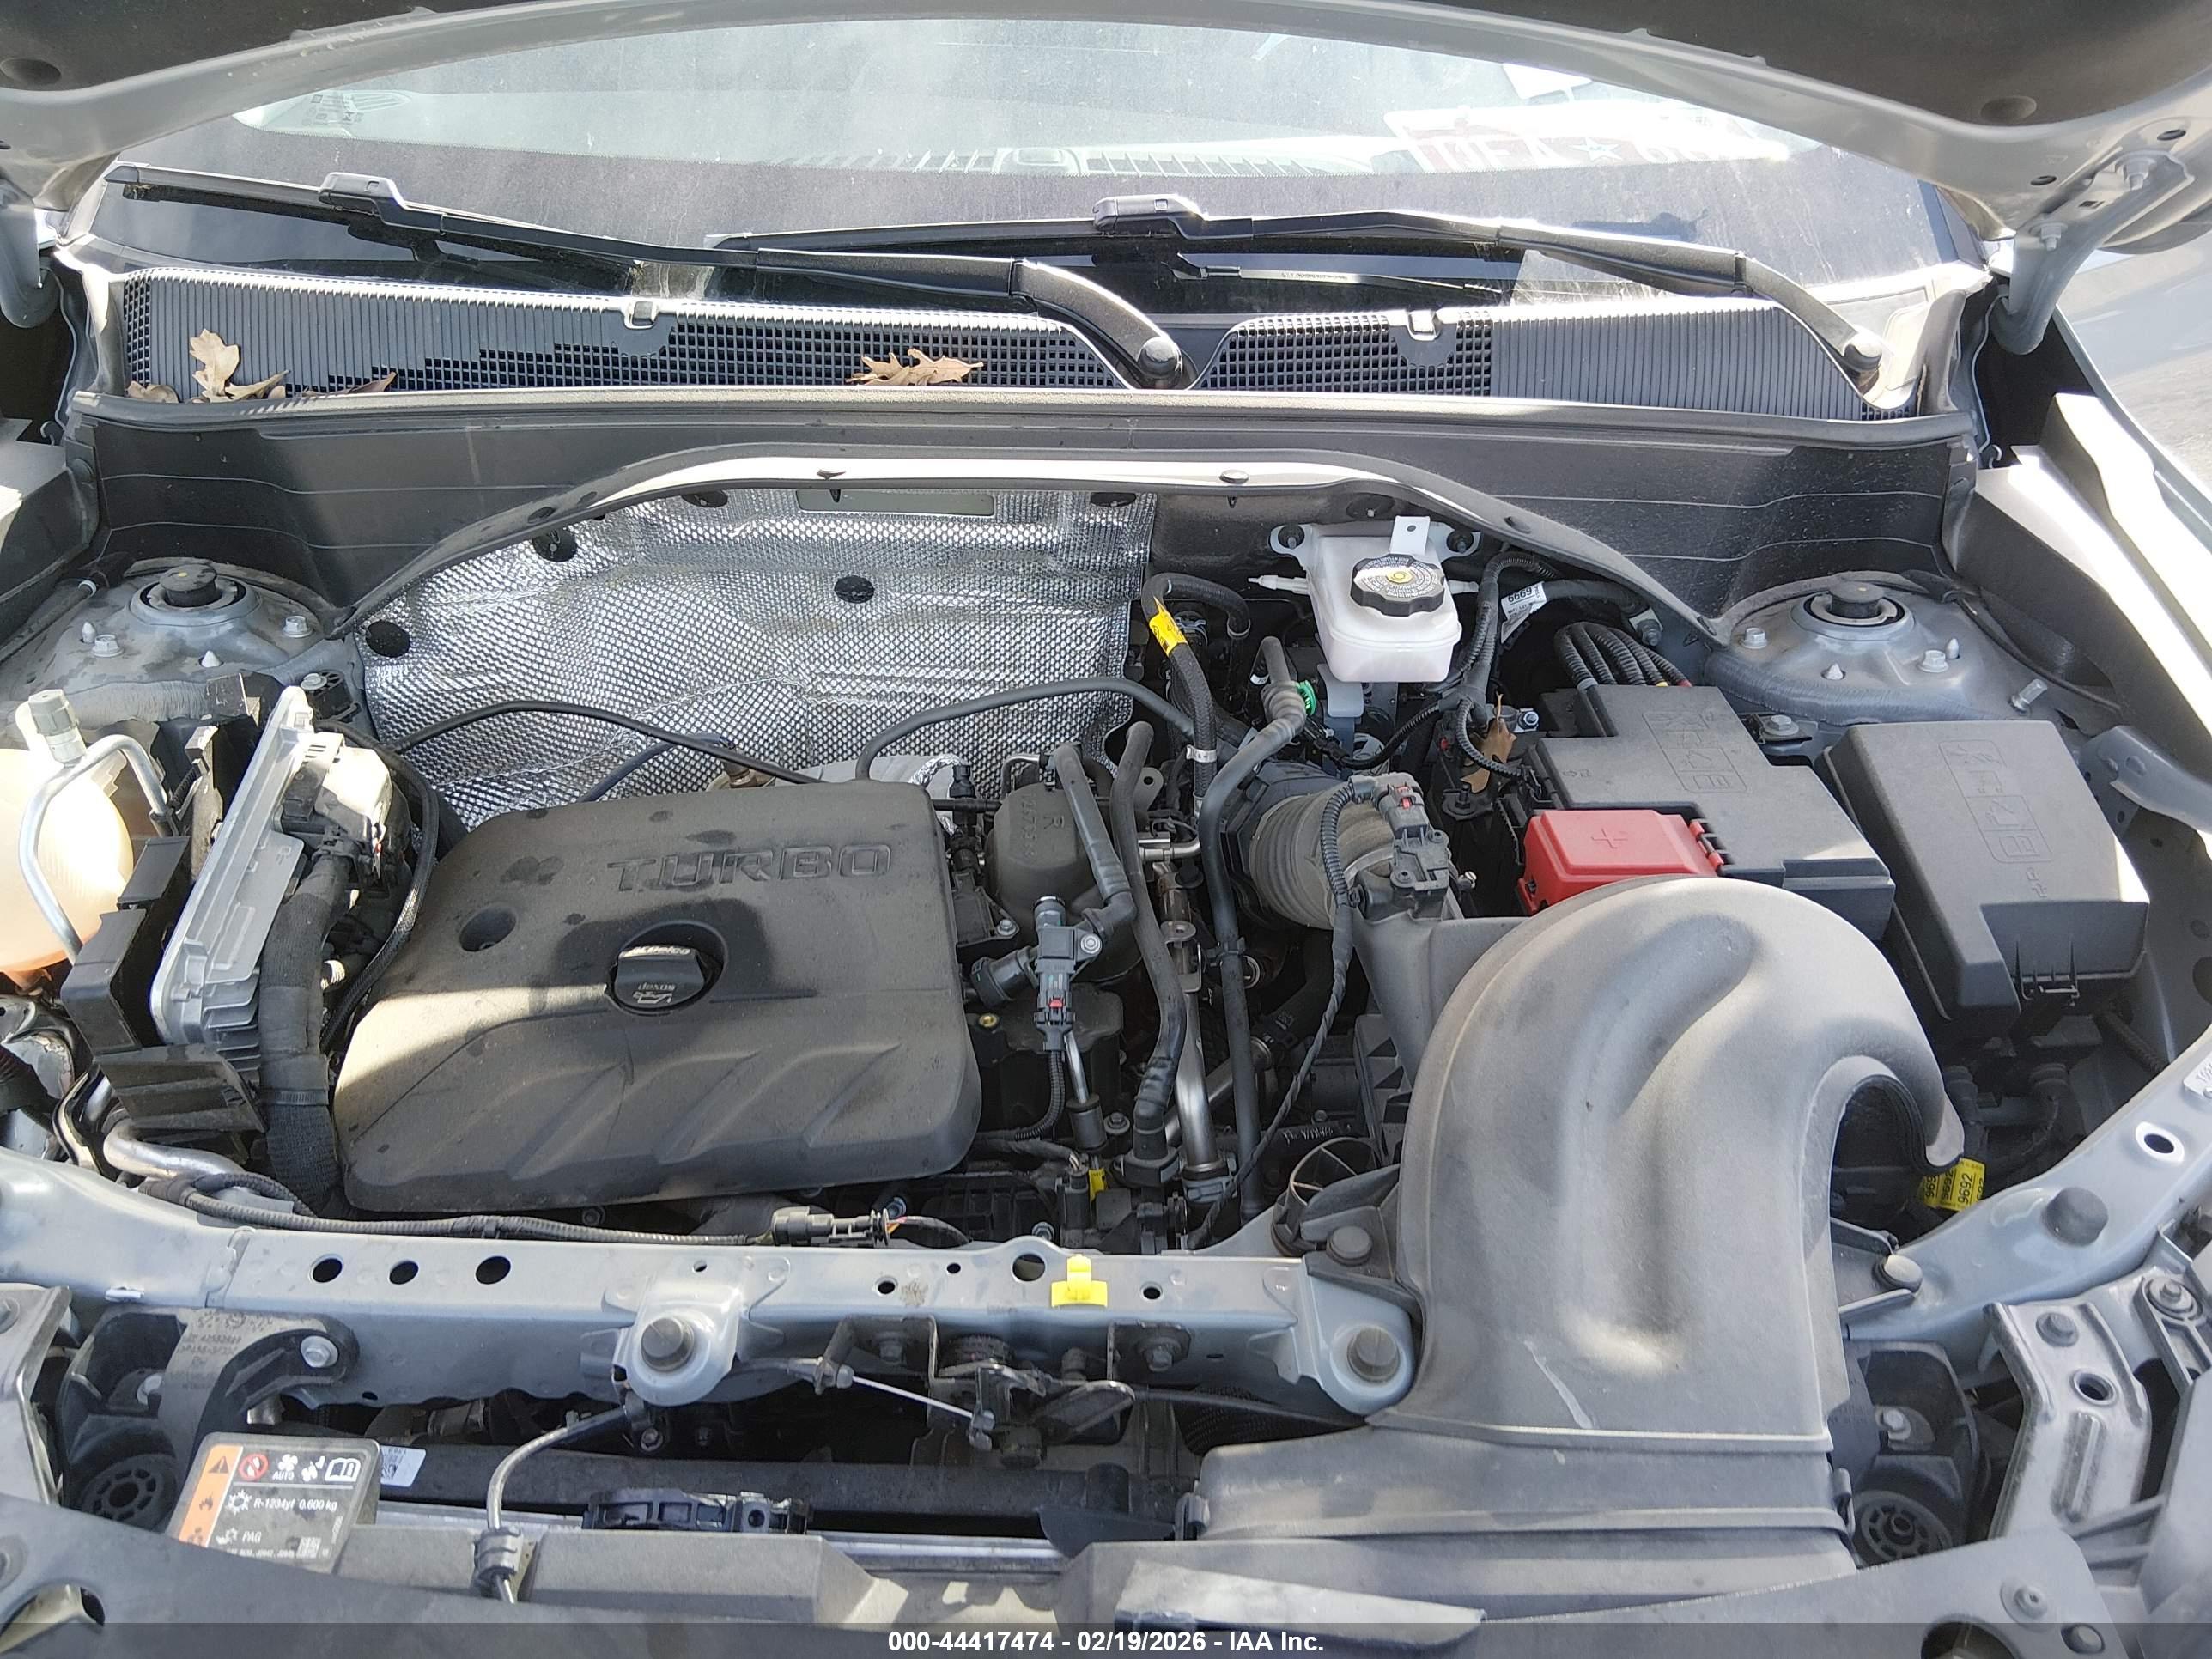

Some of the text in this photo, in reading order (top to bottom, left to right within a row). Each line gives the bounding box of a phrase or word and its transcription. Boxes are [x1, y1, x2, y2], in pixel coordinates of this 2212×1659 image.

[607, 844, 890, 892] TURBO
[638, 982, 676, 991] dexos
[1925, 1176, 1937, 1198] 969
[1958, 1173, 1973, 1205] 9692
[272, 1470, 295, 1480] AUTO
[253, 1497, 338, 1512] R-1234yf 0.600 kg
[241, 1530, 262, 1544] PAG
